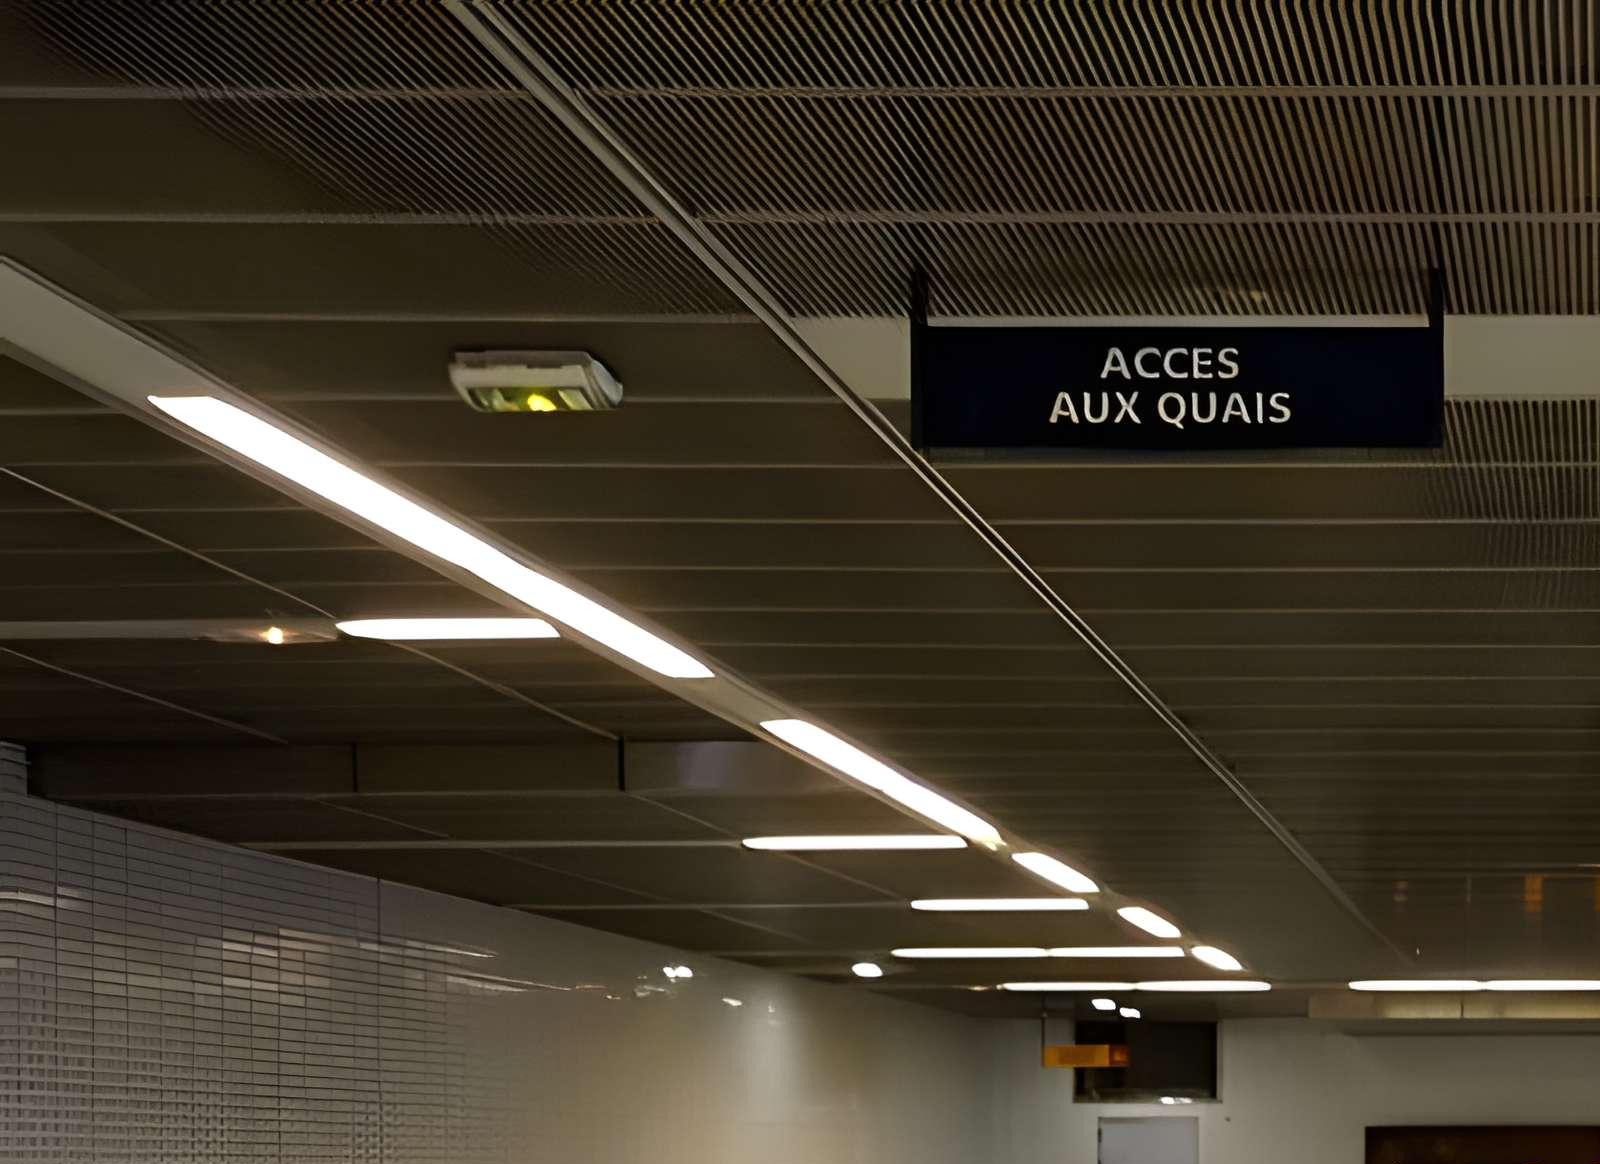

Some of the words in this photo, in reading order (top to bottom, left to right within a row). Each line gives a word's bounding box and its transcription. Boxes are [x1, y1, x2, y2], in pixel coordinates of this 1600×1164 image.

[1100, 346, 1240, 380] ACCES
[1048, 391, 1142, 424] AUX
[1157, 391, 1292, 430] QUAIS
